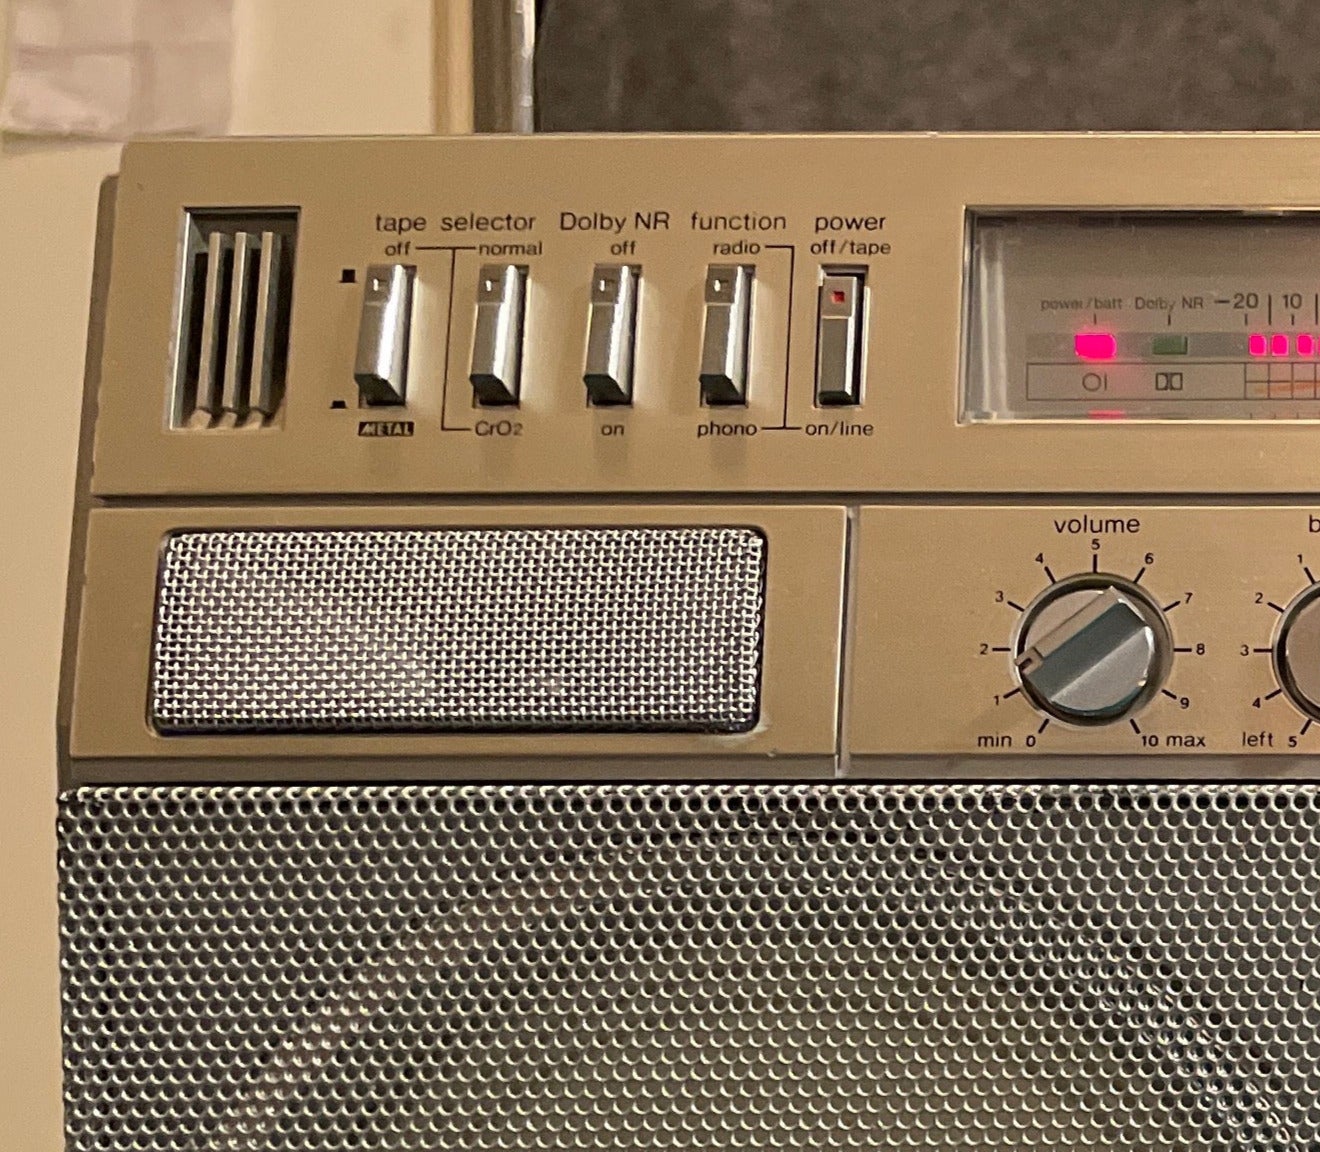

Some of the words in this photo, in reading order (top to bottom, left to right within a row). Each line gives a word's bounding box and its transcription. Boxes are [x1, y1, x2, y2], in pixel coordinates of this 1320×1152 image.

[376, 215, 426, 235] tape
[441, 213, 536, 231] selector
[560, 212, 626, 234] Dolby
[635, 211, 669, 230] NR
[692, 212, 786, 231] function
[815, 217, 885, 234] power
[385, 241, 411, 256] off
[479, 241, 542, 256] normal
[611, 240, 635, 255] off
[714, 240, 760, 255] radio
[810, 239, 891, 256] off/tape
[1040, 297, 1122, 312] power/batt
[1134, 296, 1176, 313] Dolby
[1182, 296, 1204, 309] NR
[1283, 293, 1302, 309] 10
[601, 425, 624, 436] on
[697, 421, 757, 438] phono
[806, 421, 873, 436] on/line
[1054, 514, 1140, 533] volume
[1092, 539, 1100, 550] 5
[1035, 553, 1043, 563] 4
[1145, 553, 1153, 564] 6
[995, 591, 1003, 602] 3
[1185, 592, 1193, 604] 7
[1255, 592, 1263, 604] 2
[980, 643, 988, 655] 2
[1196, 643, 1205, 655] 8
[1240, 645, 1249, 656] 3
[1180, 697, 1189, 709] 9
[978, 736, 1012, 747] min
[1026, 735, 1036, 747] 0
[1142, 735, 1158, 747] 10
[1166, 736, 1206, 747] max
[1243, 731, 1273, 747] left
[1288, 736, 1297, 747] 5
